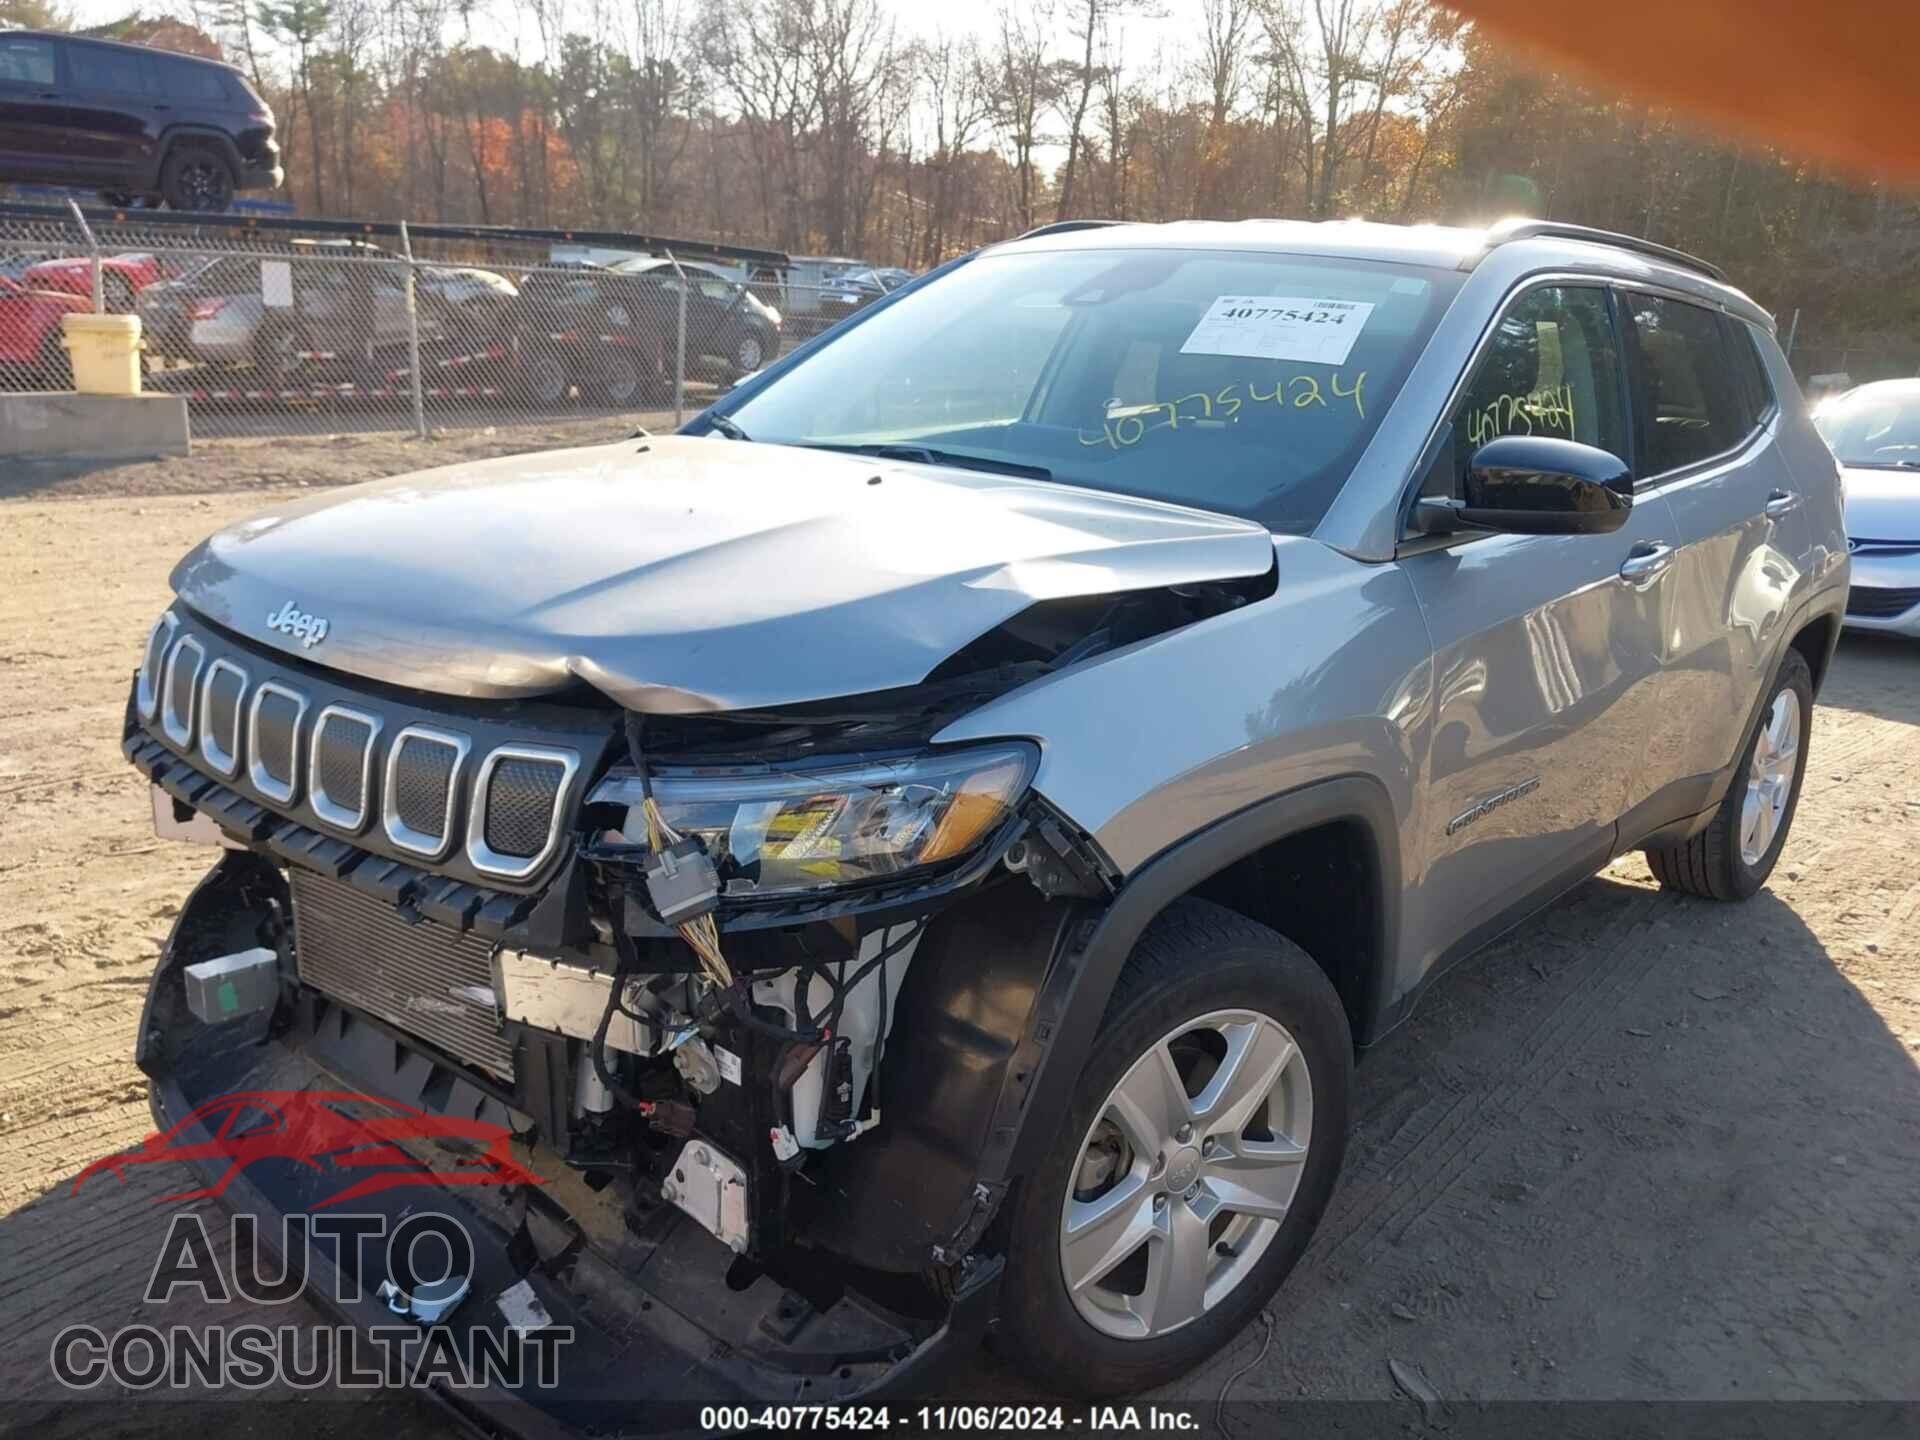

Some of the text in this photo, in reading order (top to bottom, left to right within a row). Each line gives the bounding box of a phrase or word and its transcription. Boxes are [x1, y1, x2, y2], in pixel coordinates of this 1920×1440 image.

[1221, 307, 1346, 325] 40775424
[1078, 371, 1367, 450] 40775424
[266, 600, 329, 649] Jeep
